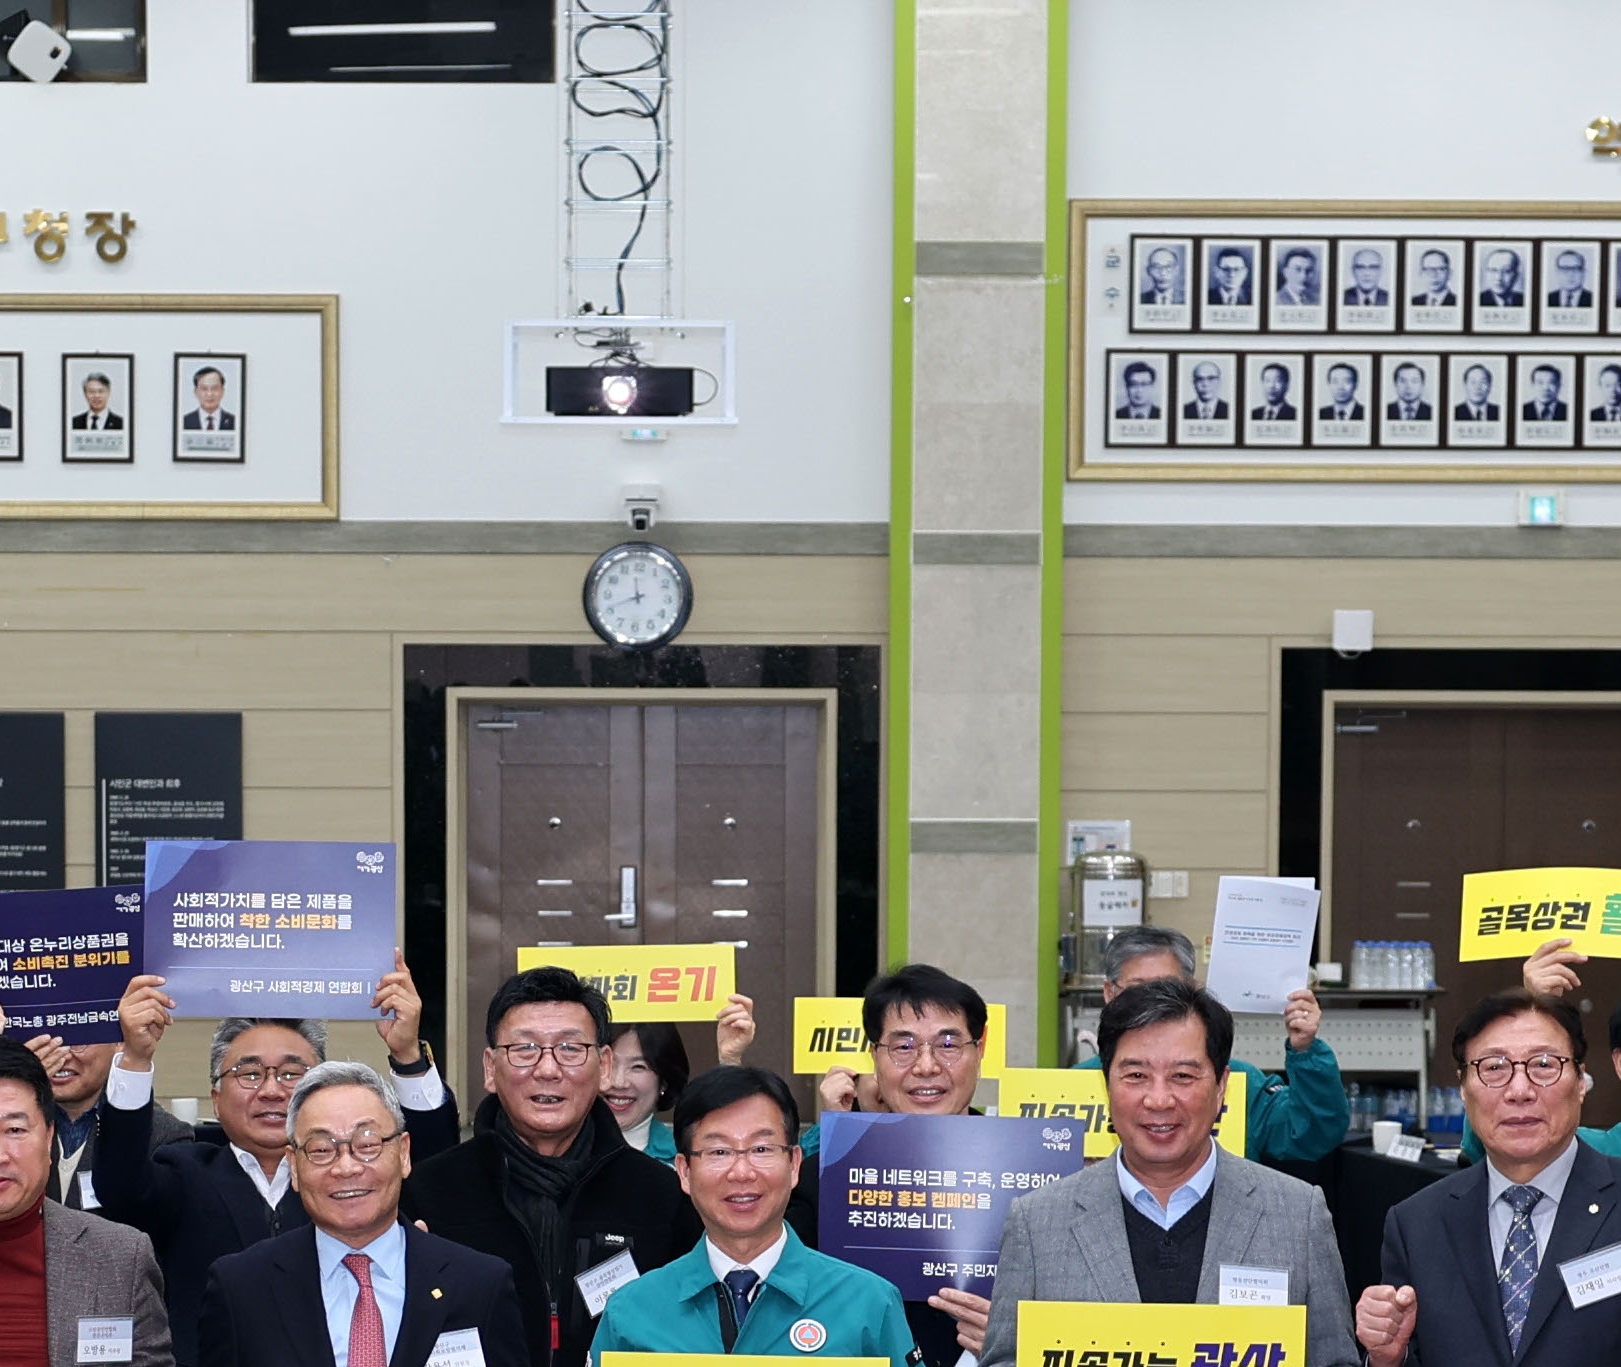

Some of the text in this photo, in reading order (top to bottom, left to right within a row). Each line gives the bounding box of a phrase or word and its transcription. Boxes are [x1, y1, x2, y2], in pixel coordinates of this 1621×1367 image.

[173, 892, 352, 910] 사회적가치를 담은 제품을
[172, 912, 352, 931] 판매하여 착한 소비문화를
[1477, 901, 1592, 936] 골목상권
[29, 932, 129, 953] 온누리상품권을
[172, 932, 286, 951] 확산하겠습니다.
[13, 955, 69, 971] 소비촉진
[74, 950, 130, 967] 분위기를
[230, 979, 363, 995] 광산구 사회적경제 연합회
[647, 966, 717, 1003] 온기
[46, 1009, 120, 1026] 광주전남금속연
[809, 1026, 873, 1054] 시민
[849, 1168, 996, 1190] 마을 네트워크를 구축,
[848, 1189, 893, 1207] 다양한
[897, 1190, 927, 1208] 홍보
[848, 1210, 956, 1230] 추진하겠습니다.
[604, 1233, 625, 1244] Jeep
[922, 1262, 959, 1277] 광산구
